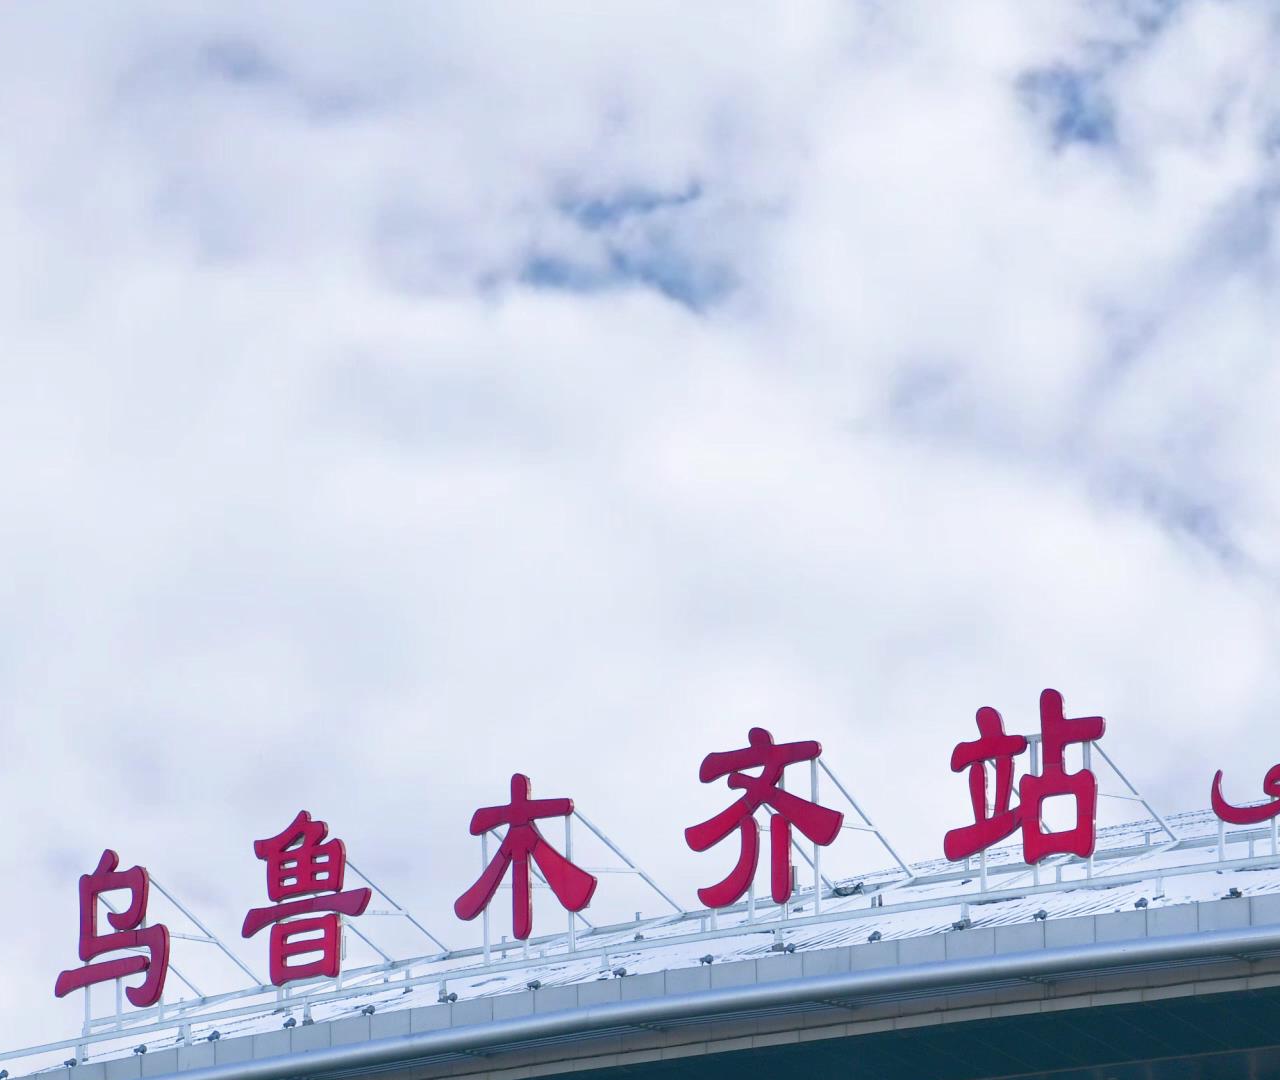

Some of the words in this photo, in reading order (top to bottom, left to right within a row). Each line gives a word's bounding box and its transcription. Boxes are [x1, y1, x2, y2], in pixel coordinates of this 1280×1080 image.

[55, 690, 1106, 1008] 乌鲁木齐站
